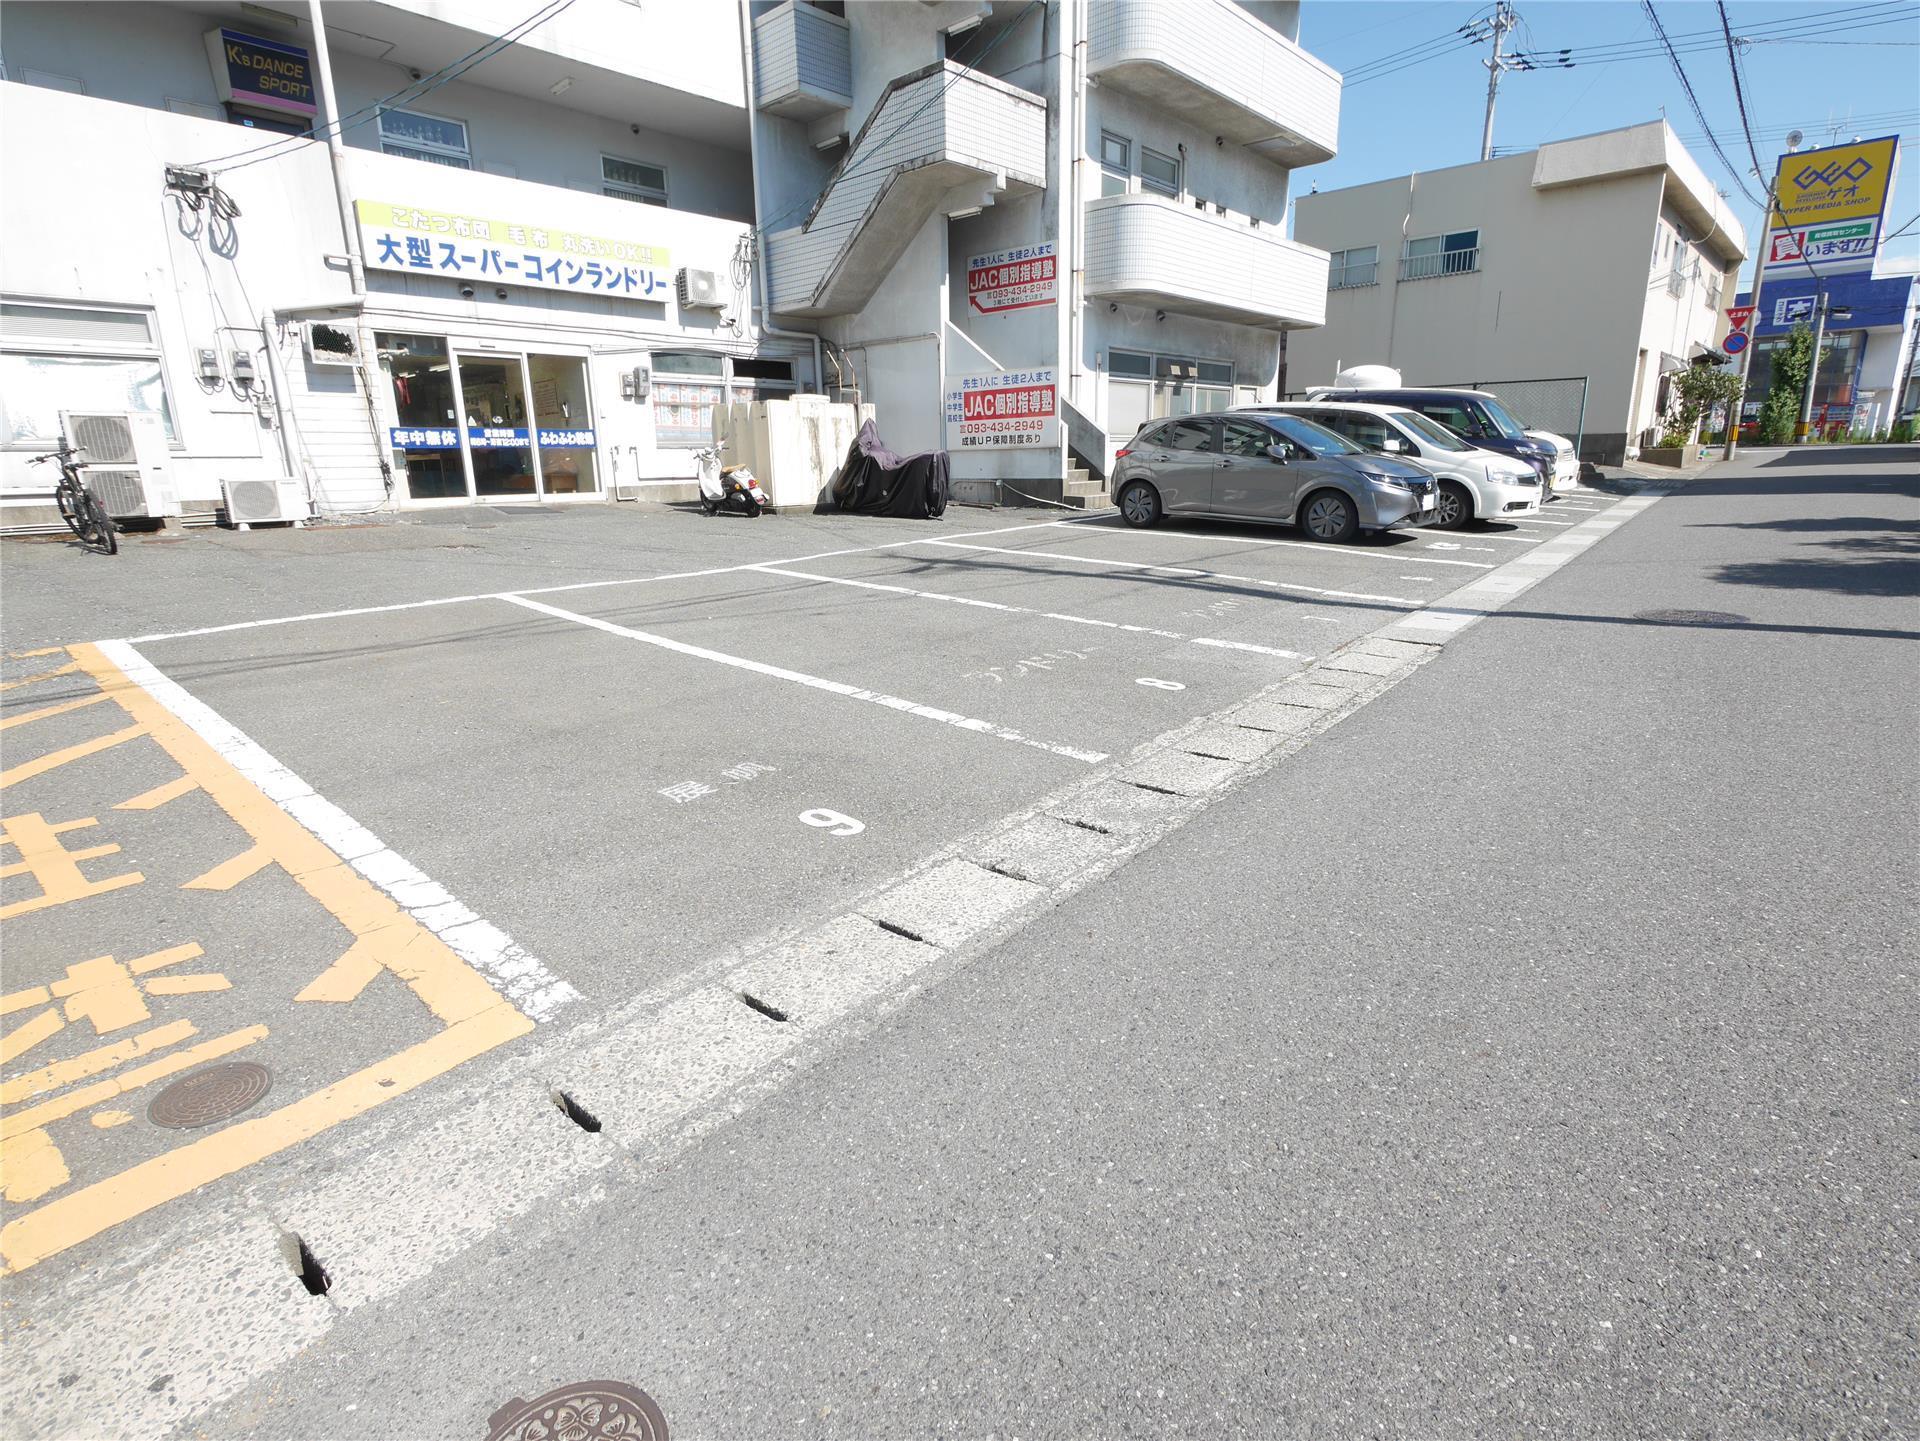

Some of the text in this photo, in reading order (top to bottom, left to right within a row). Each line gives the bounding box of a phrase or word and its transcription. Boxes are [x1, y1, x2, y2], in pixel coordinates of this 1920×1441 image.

[253, 55, 304, 79] DANCE
[259, 75, 310, 98] SPORT
[1793, 156, 1874, 190] GEO
[1827, 184, 1860, 200] ゲオ
[1814, 201, 1843, 210] MEDIA
[1845, 196, 1871, 206] SHOP
[391, 207, 491, 241] こたつ布団
[973, 244, 1052, 268] 先生1人に 生徒2人まで
[970, 260, 1054, 289] JAC個別指導塾
[1730, 310, 1749, 318] 止まれ
[963, 371, 1052, 389] 先生1人に 生徒2人まで
[947, 392, 963, 401] 小学生
[965, 389, 1053, 417] JAC個別指導塾
[947, 403, 963, 411] 中学生
[947, 414, 963, 423] 高校生
[967, 420, 1044, 434] 093-434-2949
[393, 430, 457, 446] 年中無休
[1134, 677, 1187, 691] 8
[798, 807, 866, 837] 9
